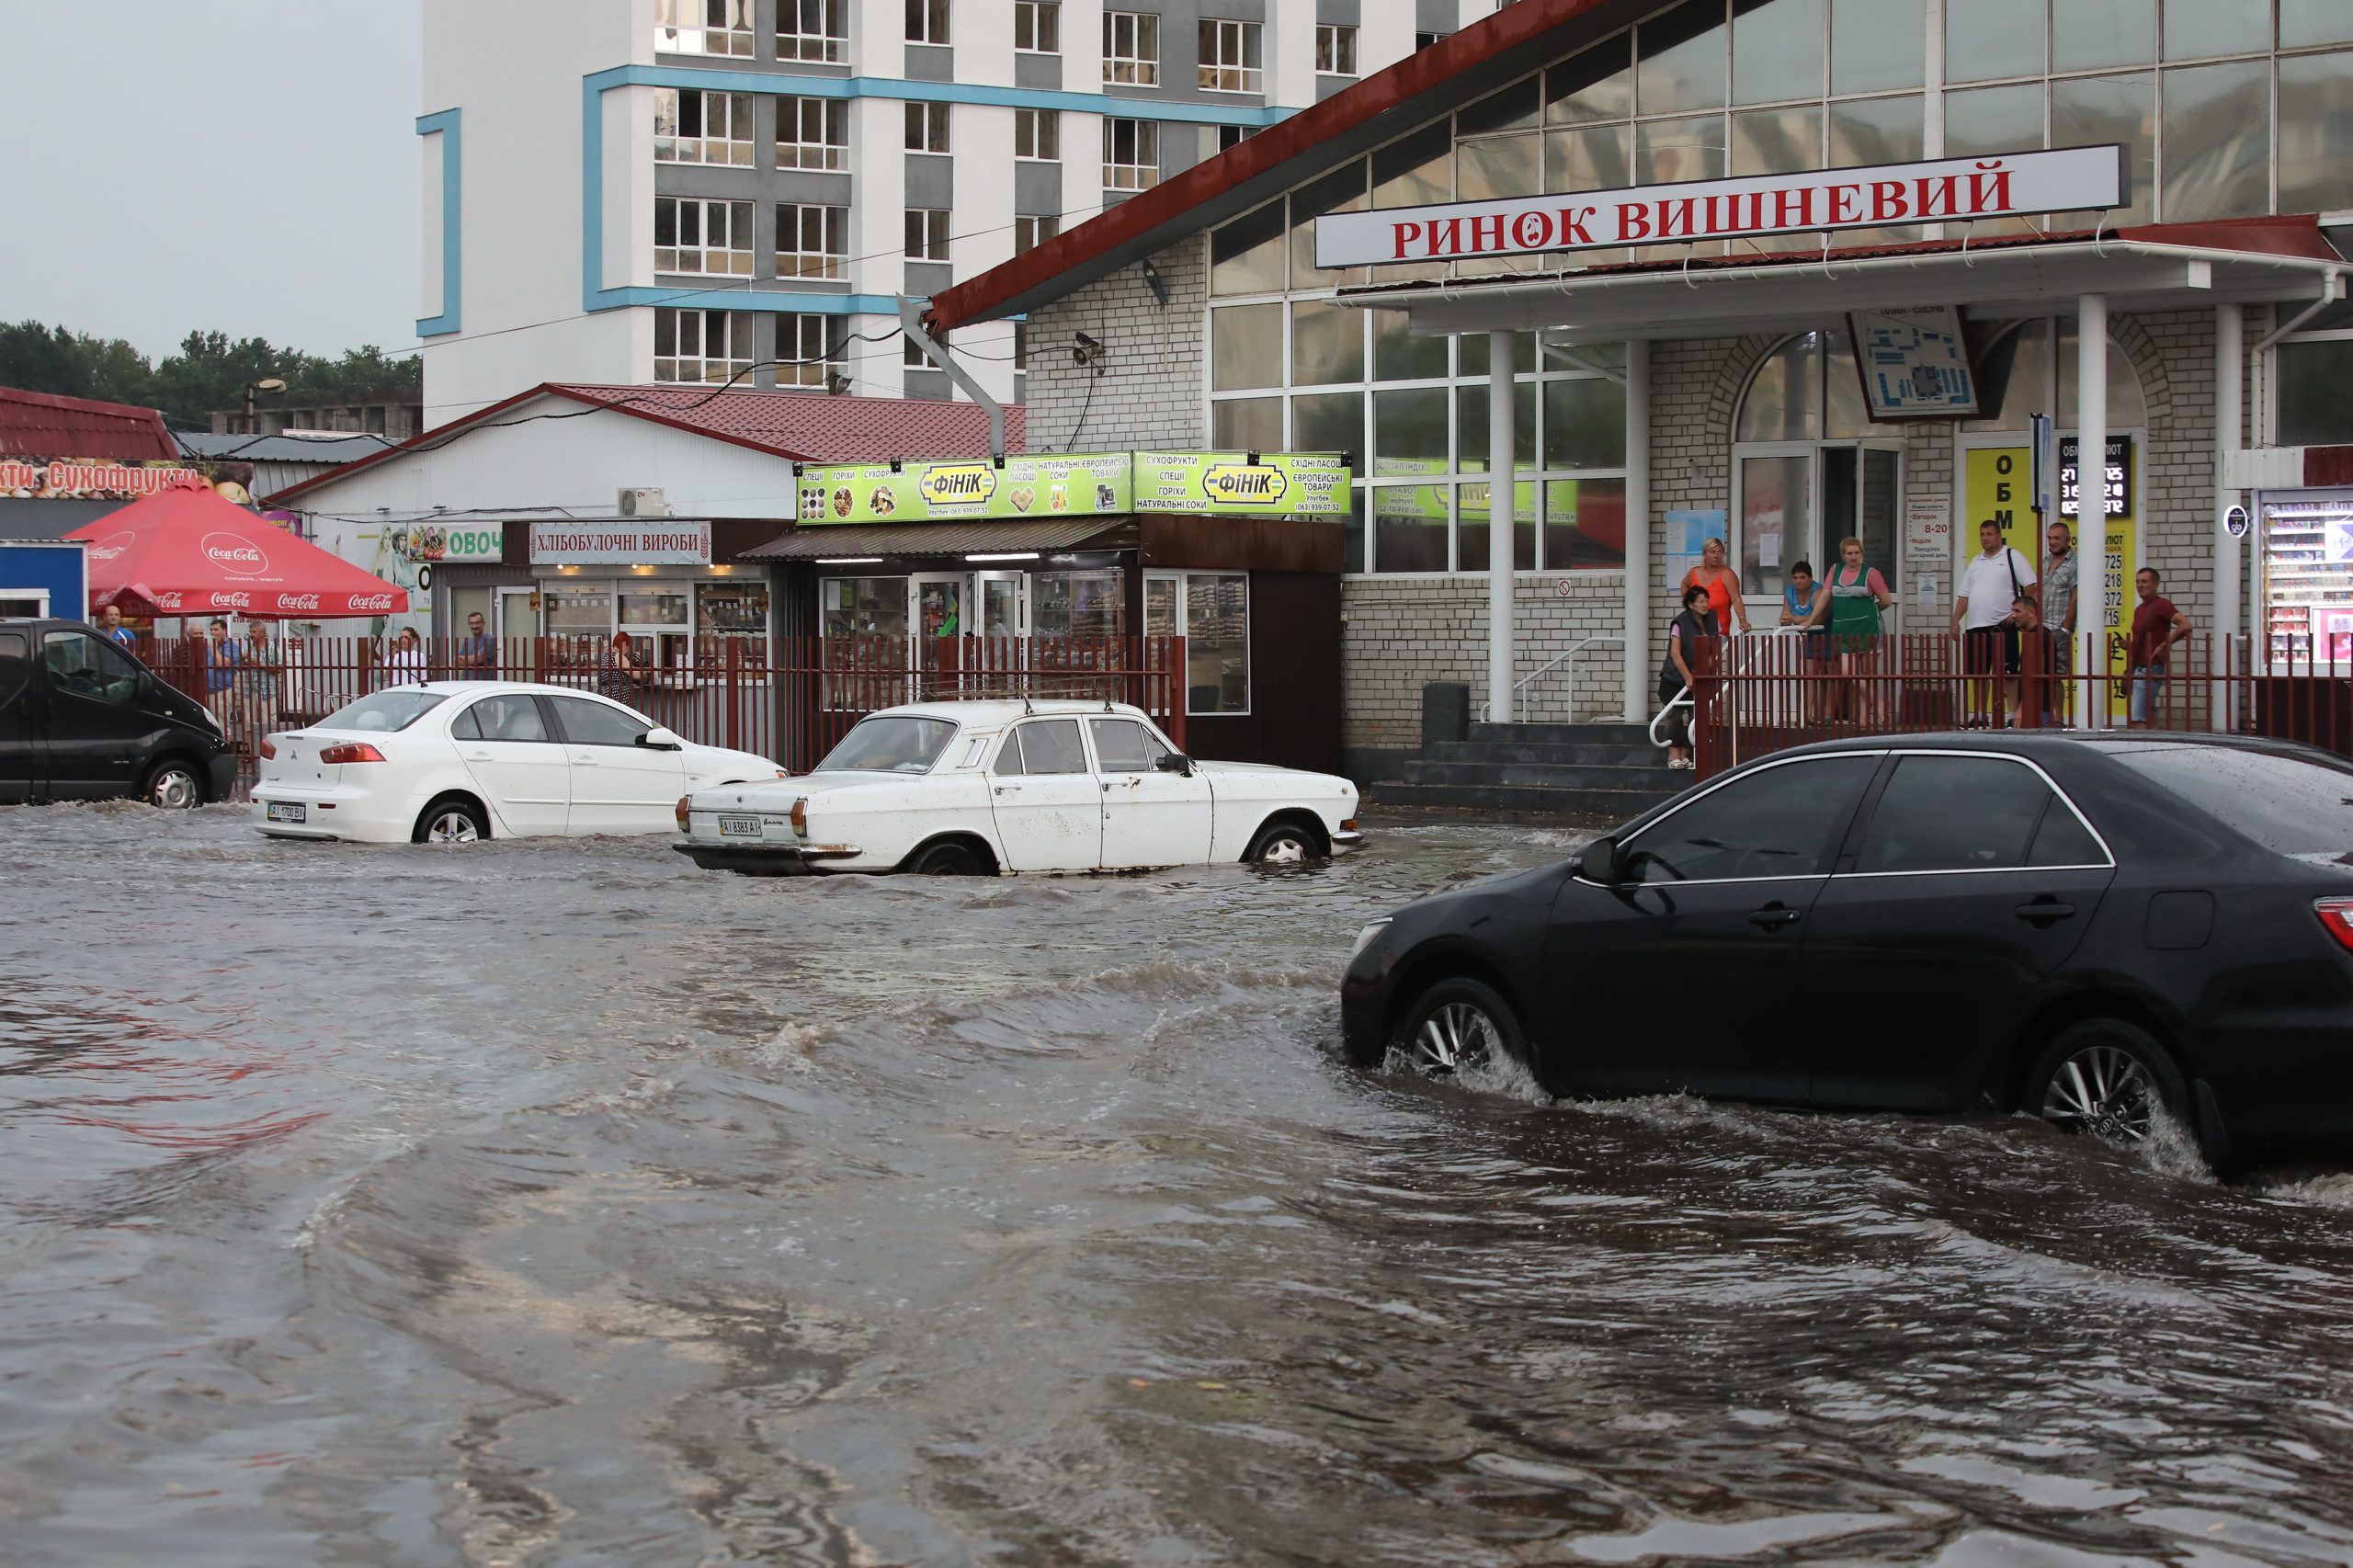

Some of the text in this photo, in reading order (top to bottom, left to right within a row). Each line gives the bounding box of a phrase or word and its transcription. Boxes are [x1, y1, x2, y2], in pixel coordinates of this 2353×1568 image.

[1391, 160, 2016, 258] РИНОК ВИШНЕВИЙ
[1039, 460, 1079, 470] НАТУРАЛЬНІ
[1146, 457, 1197, 465] СУХОФРУКТИ
[1290, 460, 1315, 468] СХІДНІ
[1050, 472, 1067, 480] СОКИ
[1092, 470, 1119, 478] ТОВАРИ
[1159, 471, 1185, 482] СПЕЦІЇ
[1293, 473, 1343, 483] ЄВРОПЕЙСЬКІ
[1158, 487, 1186, 495] ГОРІХИ
[1303, 483, 1332, 491] ТОВАРИ
[1137, 500, 1184, 508] НАТУРАЛЬНІ
[1925, 524, 1948, 533] 8-20
[537, 534, 698, 551] ХЛІБОБУЛОЧНІ ВИРОБИ
[2105, 574, 2122, 587] 218
[211, 591, 251, 608] Coca-Cola
[278, 593, 321, 610] Coca-Cola
[348, 594, 394, 610] Coca-Cola
[2105, 592, 2122, 607] 372
[281, 805, 294, 817] 1700
[723, 822, 759, 834] AI 8383 AI
